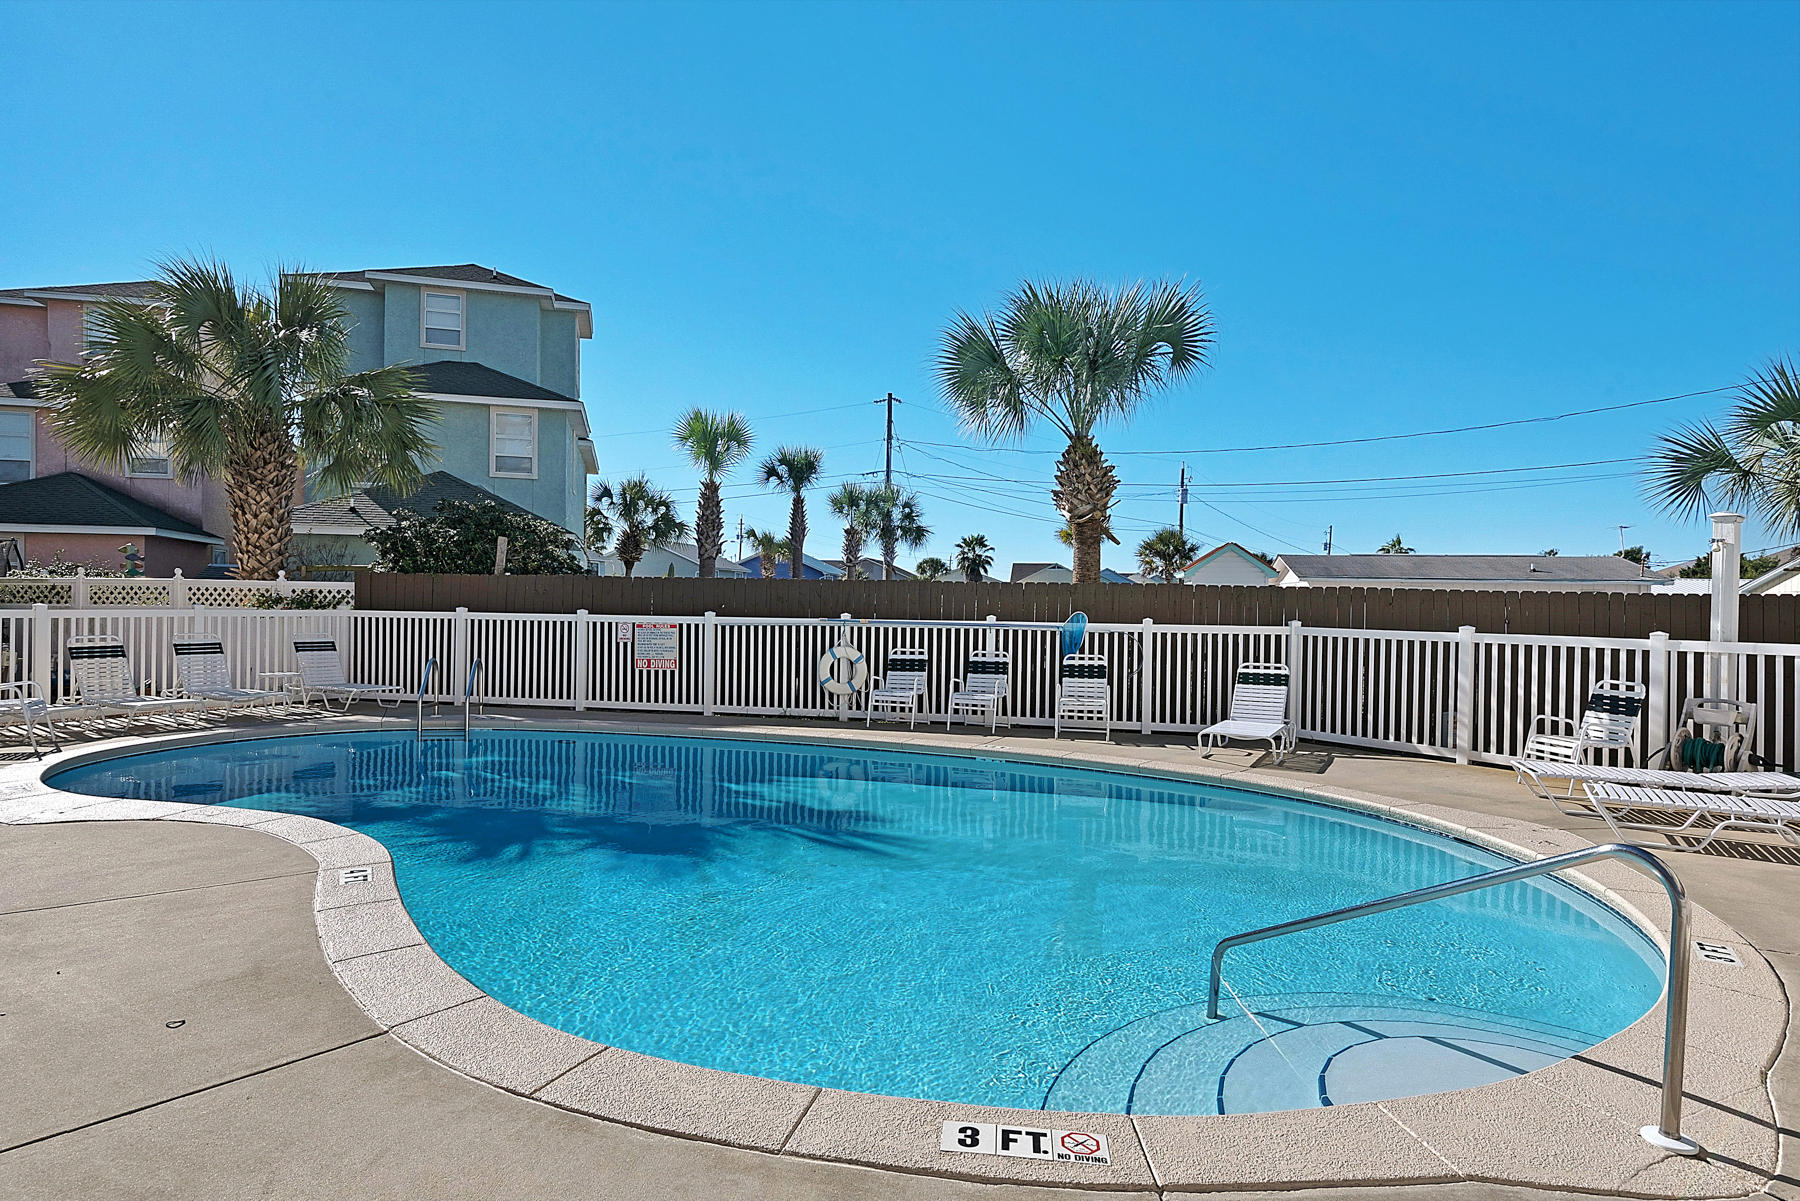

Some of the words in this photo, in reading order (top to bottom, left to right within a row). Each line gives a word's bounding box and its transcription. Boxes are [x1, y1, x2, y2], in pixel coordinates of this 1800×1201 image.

[637, 659, 648, 668] NO
[650, 659, 675, 668] DIVING
[957, 1126, 980, 1148] 3
[1001, 1128, 1049, 1155] FT.
[1057, 1152, 1071, 1161] NO
[1074, 1153, 1108, 1164] DIVING
